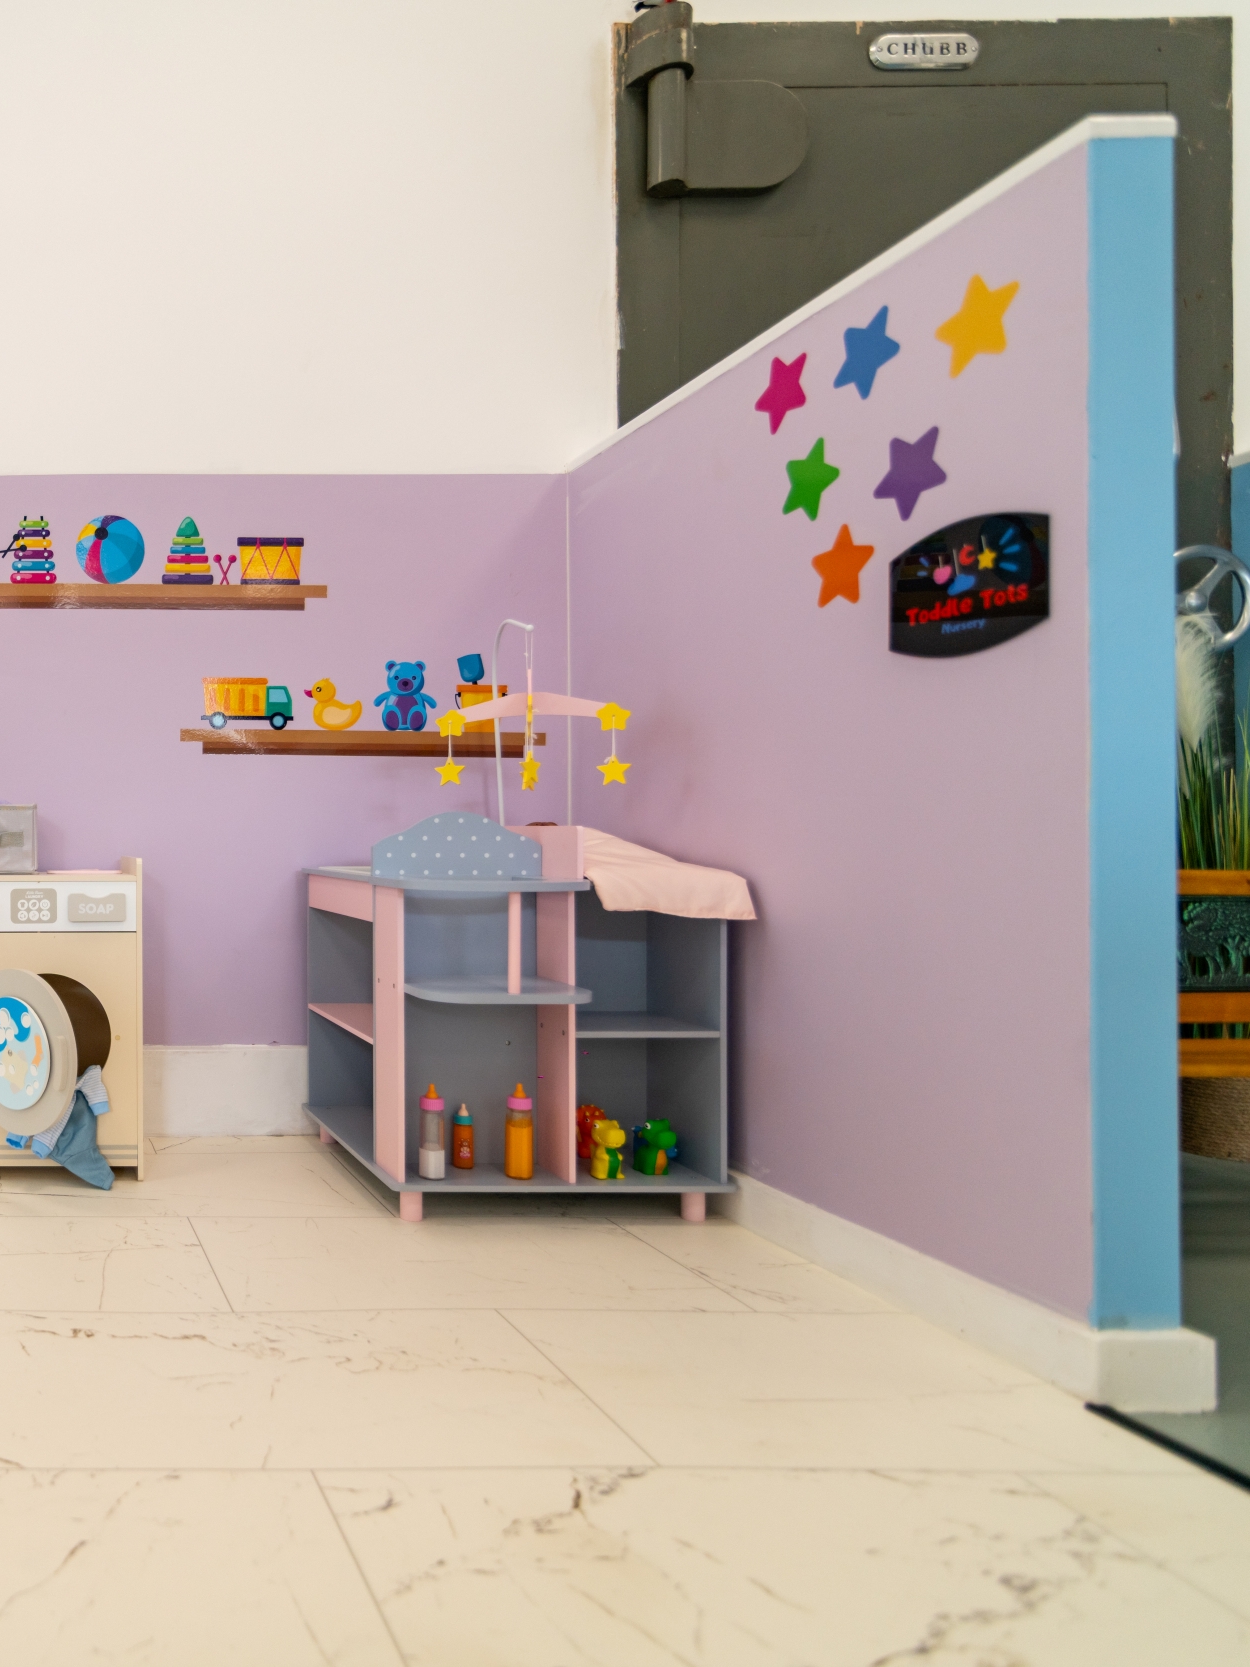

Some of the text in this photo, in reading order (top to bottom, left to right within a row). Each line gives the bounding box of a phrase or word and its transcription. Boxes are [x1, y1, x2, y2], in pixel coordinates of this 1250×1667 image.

[887, 42, 968, 56] CHUBB
[906, 583, 1029, 627] Toddle Tots
[941, 618, 987, 634] Nursery
[78, 903, 115, 915] SOAP
